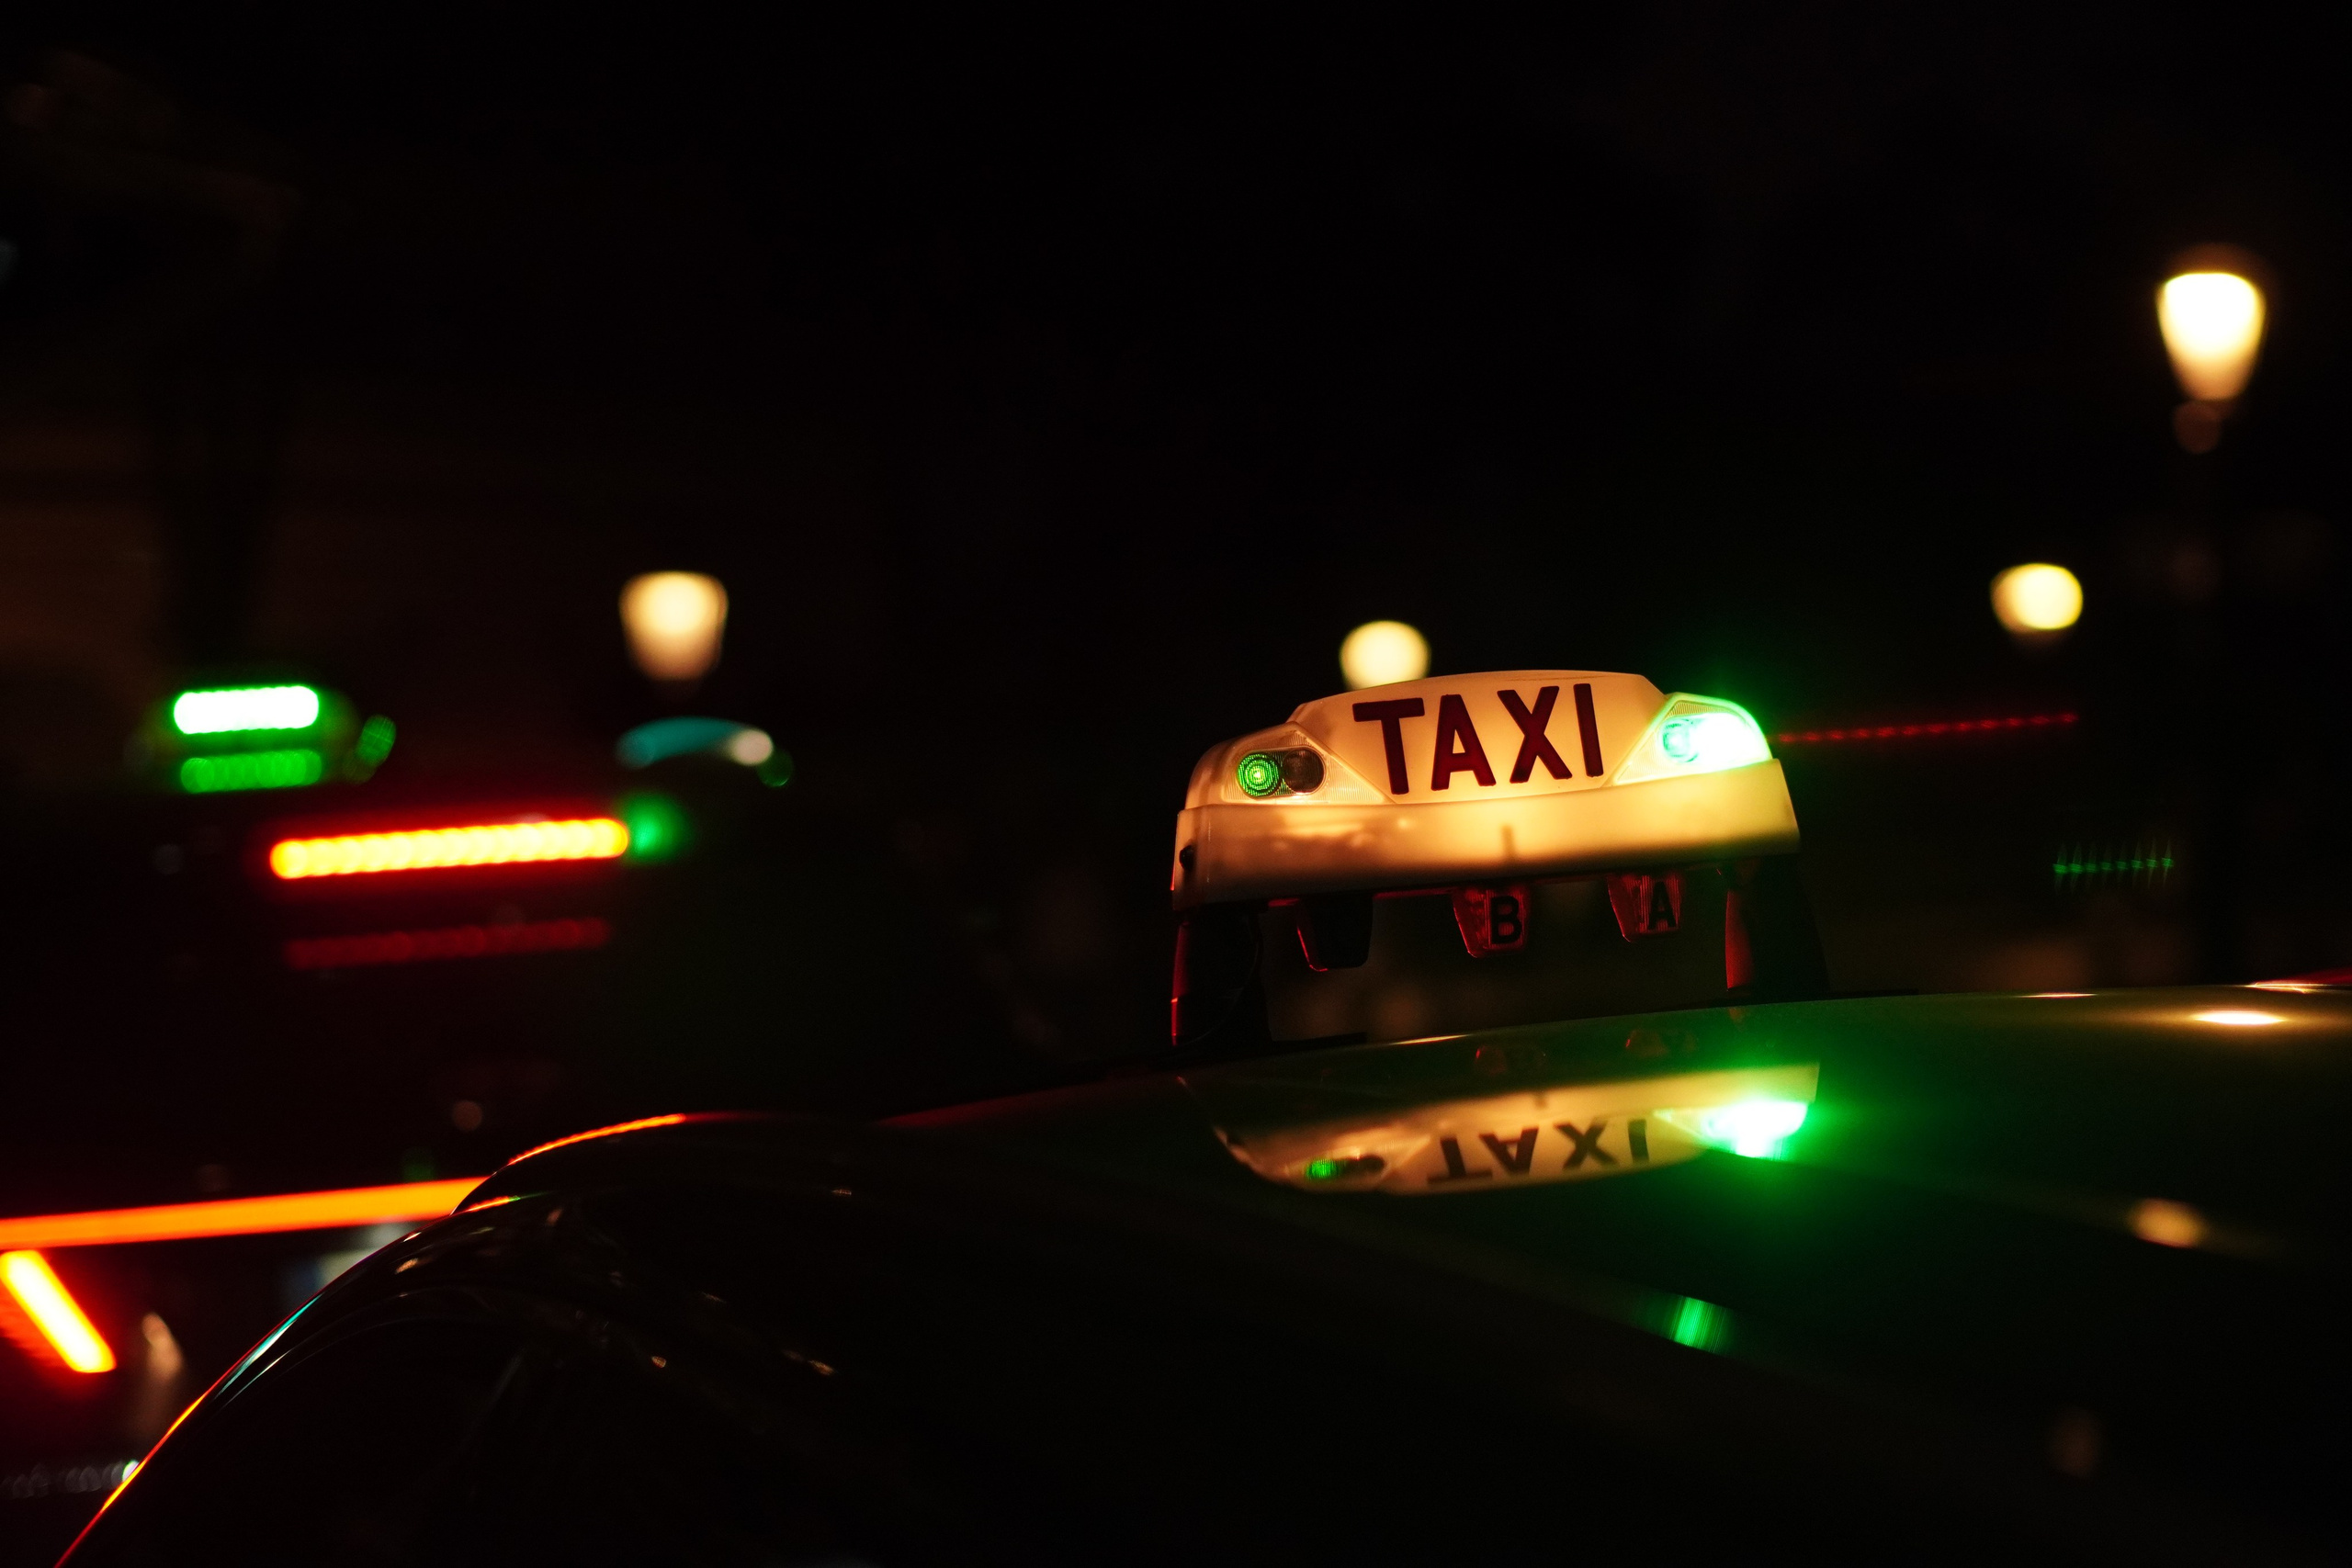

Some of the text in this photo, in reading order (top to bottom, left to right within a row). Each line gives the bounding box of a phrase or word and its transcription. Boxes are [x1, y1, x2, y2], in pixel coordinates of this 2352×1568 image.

[1352, 683, 1603, 795] TAXI
[1491, 896, 1521, 944] B
[1648, 881, 1678, 930] A
